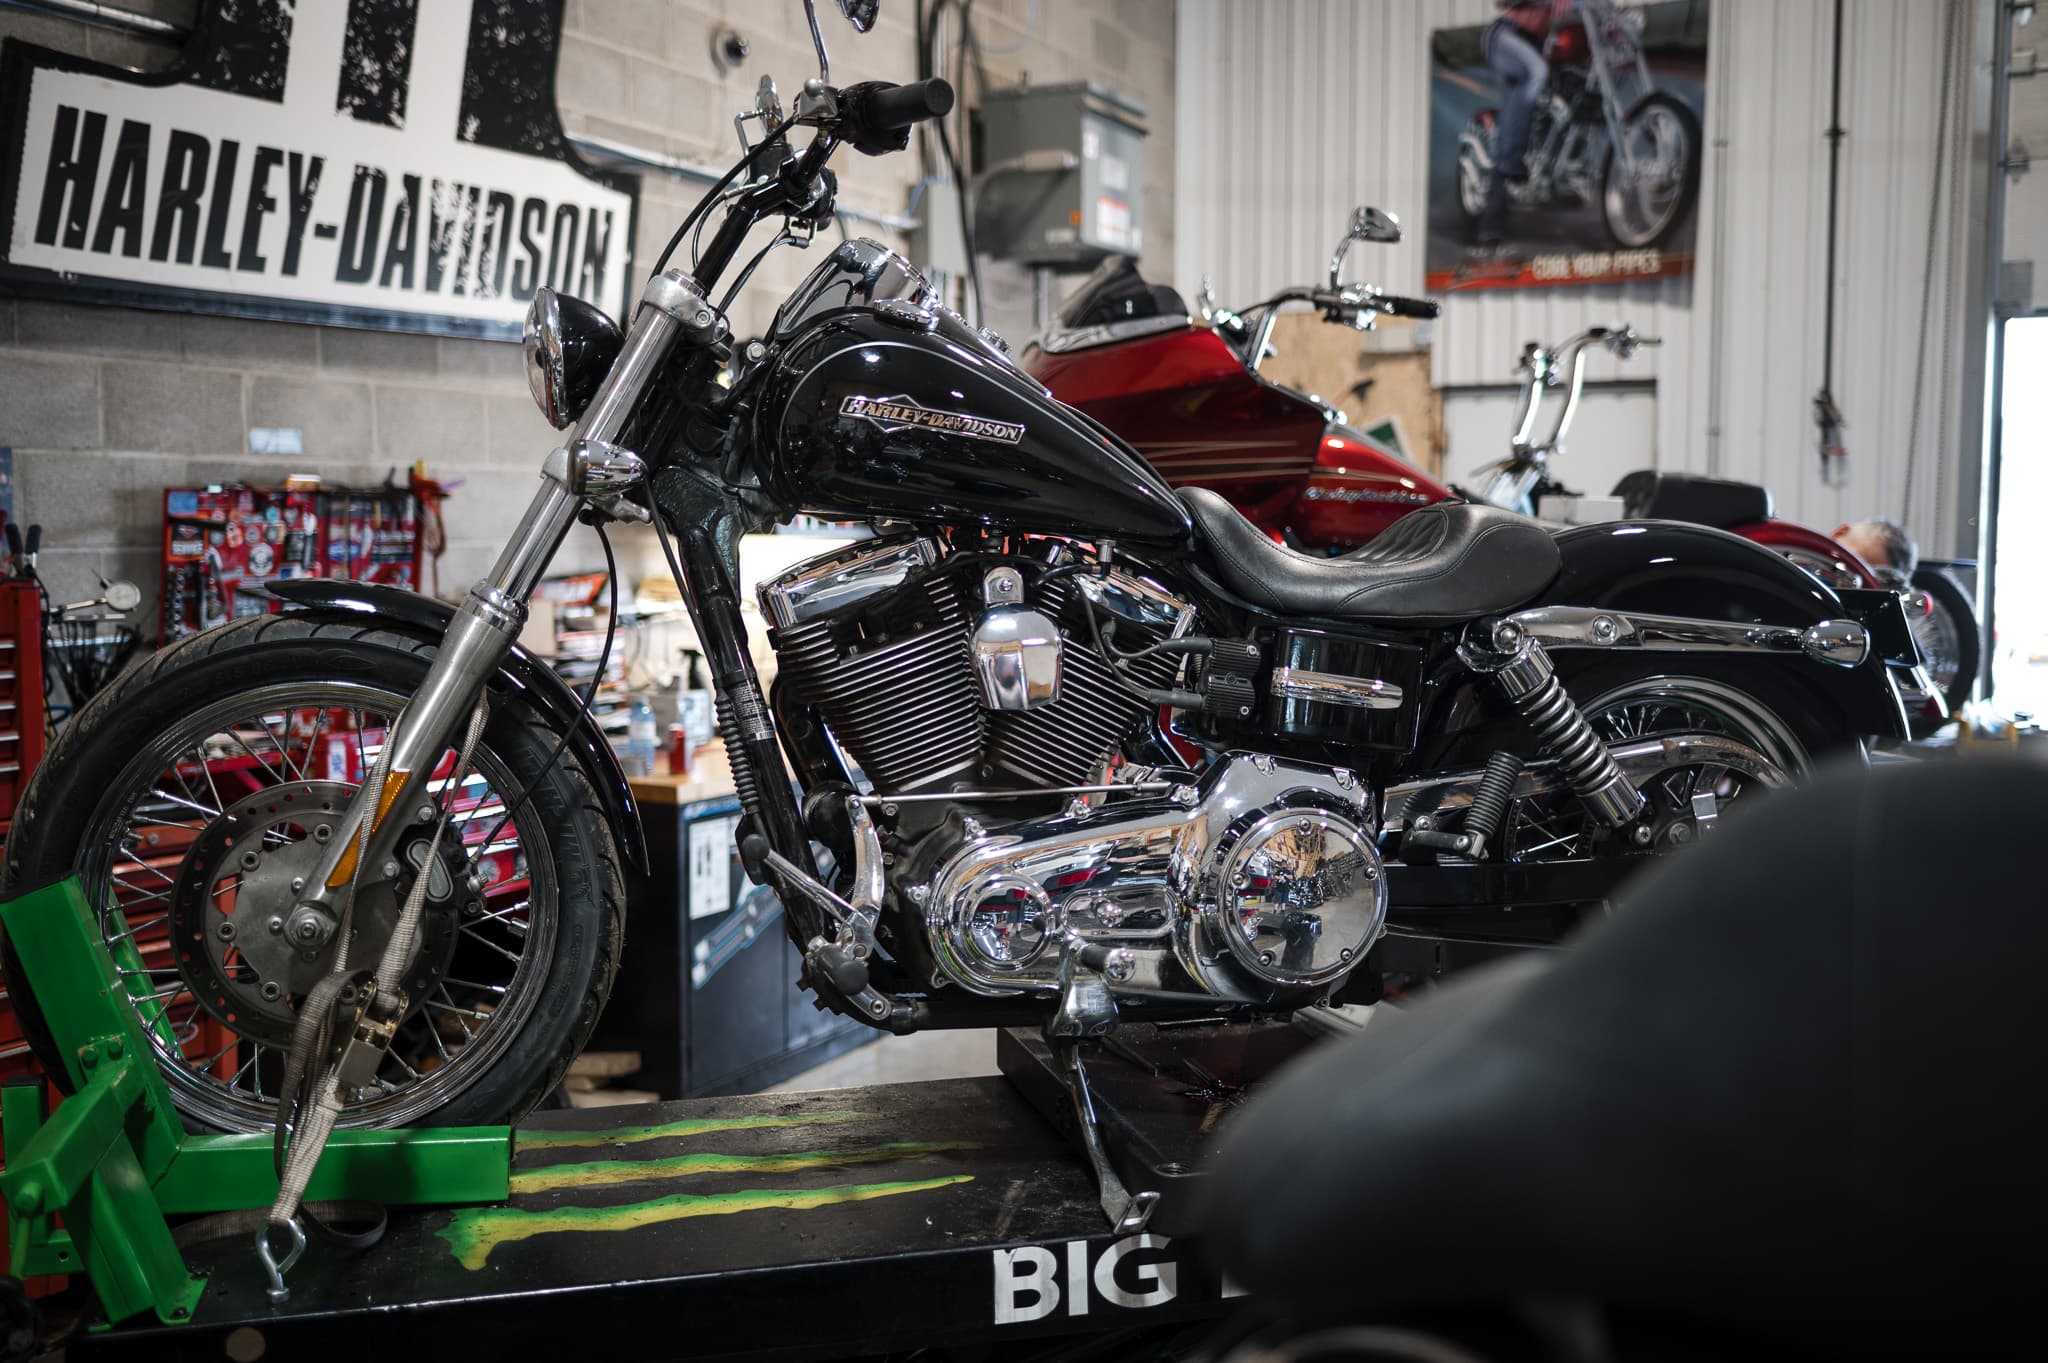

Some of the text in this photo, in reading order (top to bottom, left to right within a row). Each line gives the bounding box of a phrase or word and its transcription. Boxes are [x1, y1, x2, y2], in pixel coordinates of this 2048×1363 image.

[34, 104, 614, 302] HARLEY-DAVIDSON
[846, 399, 1018, 441] HARLEY-DAVIDSON
[993, 1233, 1178, 1325] BIG
